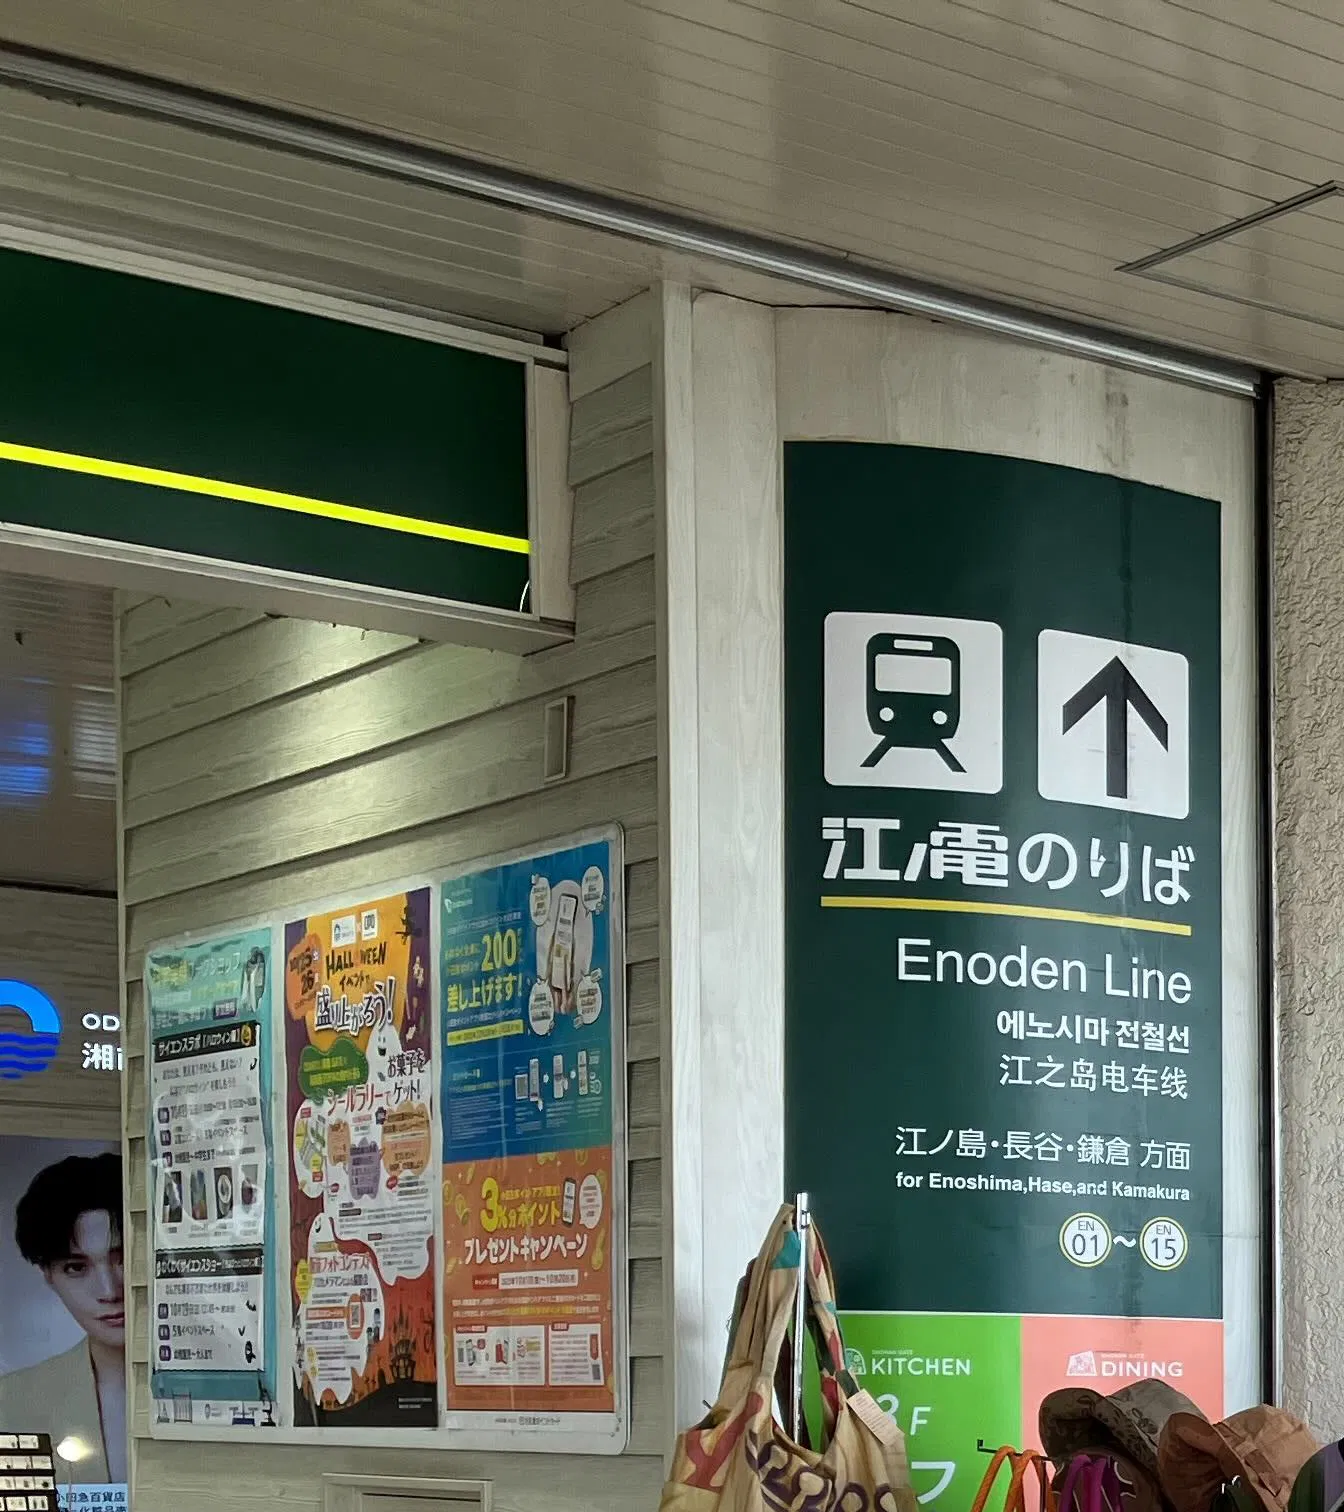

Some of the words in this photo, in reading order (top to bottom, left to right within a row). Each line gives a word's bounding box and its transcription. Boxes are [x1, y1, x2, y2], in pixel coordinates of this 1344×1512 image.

[821, 816, 1196, 905] 江ノ電のりば
[482, 929, 517, 972] 200
[897, 937, 1088, 993] Enoden
[1105, 953, 1192, 1004] Line
[996, 1010, 1110, 1047] 에노시마
[1115, 1020, 1190, 1054] 전철선
[999, 1054, 1188, 1100] 江之岛电车线
[1139, 1139, 1191, 1171] 方面
[896, 1171, 924, 1188] for
[1112, 1181, 1190, 1200] Kamakura
[1077, 1219, 1095, 1232] EN
[1155, 1224, 1172, 1237] EN
[464, 1233, 588, 1265] プレゼントキャンペーン
[1072, 1233, 1099, 1257] 01
[1150, 1237, 1176, 1260] 15
[872, 1358, 971, 1376] KITCHEN
[1101, 1360, 1183, 1377] DINING
